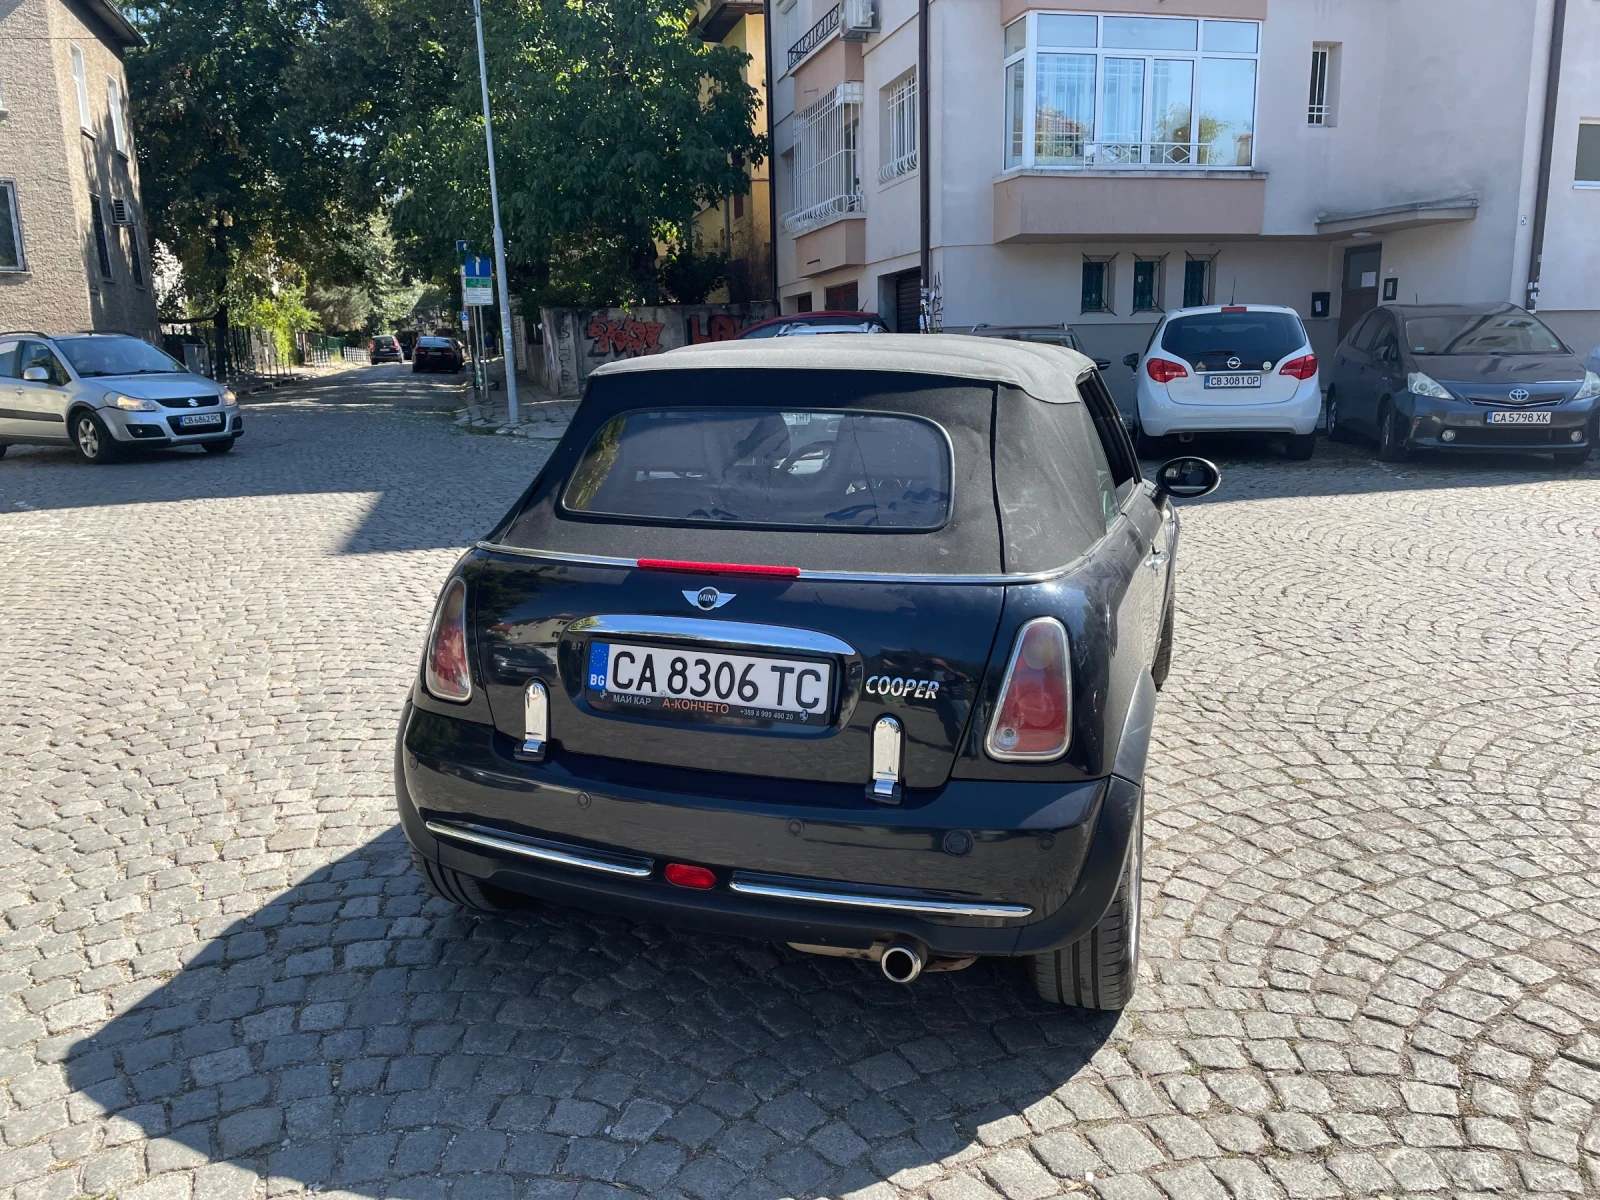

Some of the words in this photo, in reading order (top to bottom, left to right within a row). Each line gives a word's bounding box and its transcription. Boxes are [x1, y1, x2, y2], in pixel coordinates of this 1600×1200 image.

[1211, 377, 1222, 386] CB
[1223, 377, 1245, 386] 3081
[1246, 376, 1259, 385] OP
[1493, 413, 1507, 423] CA
[1508, 413, 1534, 423] 5798
[1535, 413, 1549, 423] XK
[699, 594, 717, 602] MINI
[590, 674, 605, 686] BG
[612, 651, 657, 693] CA
[667, 656, 759, 703] 8306
[770, 665, 821, 709] TC
[865, 675, 940, 700] COOPER
[612, 694, 633, 704] МАЙ
[633, 697, 652, 706] КАР
[662, 699, 730, 714] А-КОНЧЕТО
